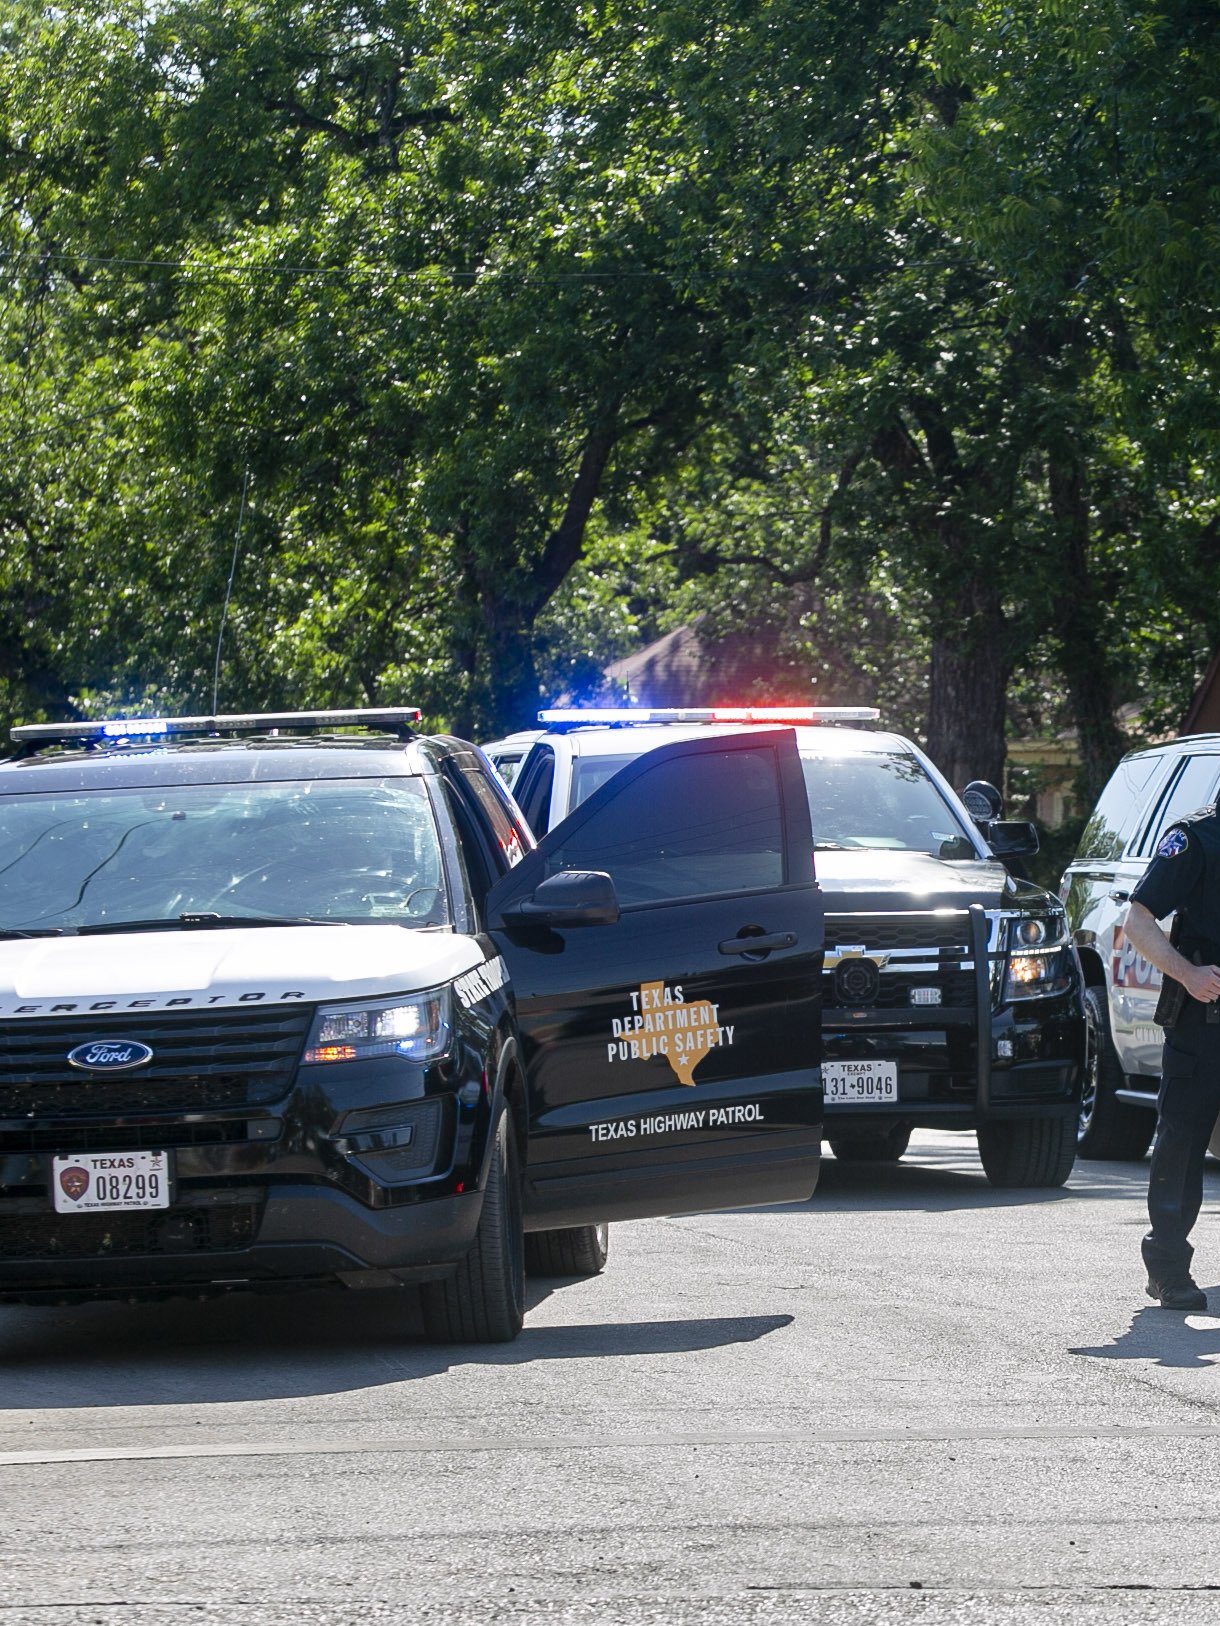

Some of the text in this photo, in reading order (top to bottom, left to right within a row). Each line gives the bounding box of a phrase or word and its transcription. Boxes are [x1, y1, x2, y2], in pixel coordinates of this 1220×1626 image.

[0, 991, 305, 1013] ERCEPTOR
[630, 986, 684, 1011] TEXAS
[612, 1004, 719, 1038] DEPARTMENT
[86, 1044, 131, 1063] Ford
[607, 1026, 735, 1062] PUBLIC SAFETY
[841, 1064, 872, 1072] TEXAS
[589, 1104, 764, 1142] TEXAS HIGHWAY PATROL
[91, 1158, 135, 1170] TEXAS
[96, 1174, 159, 1201] 08299
